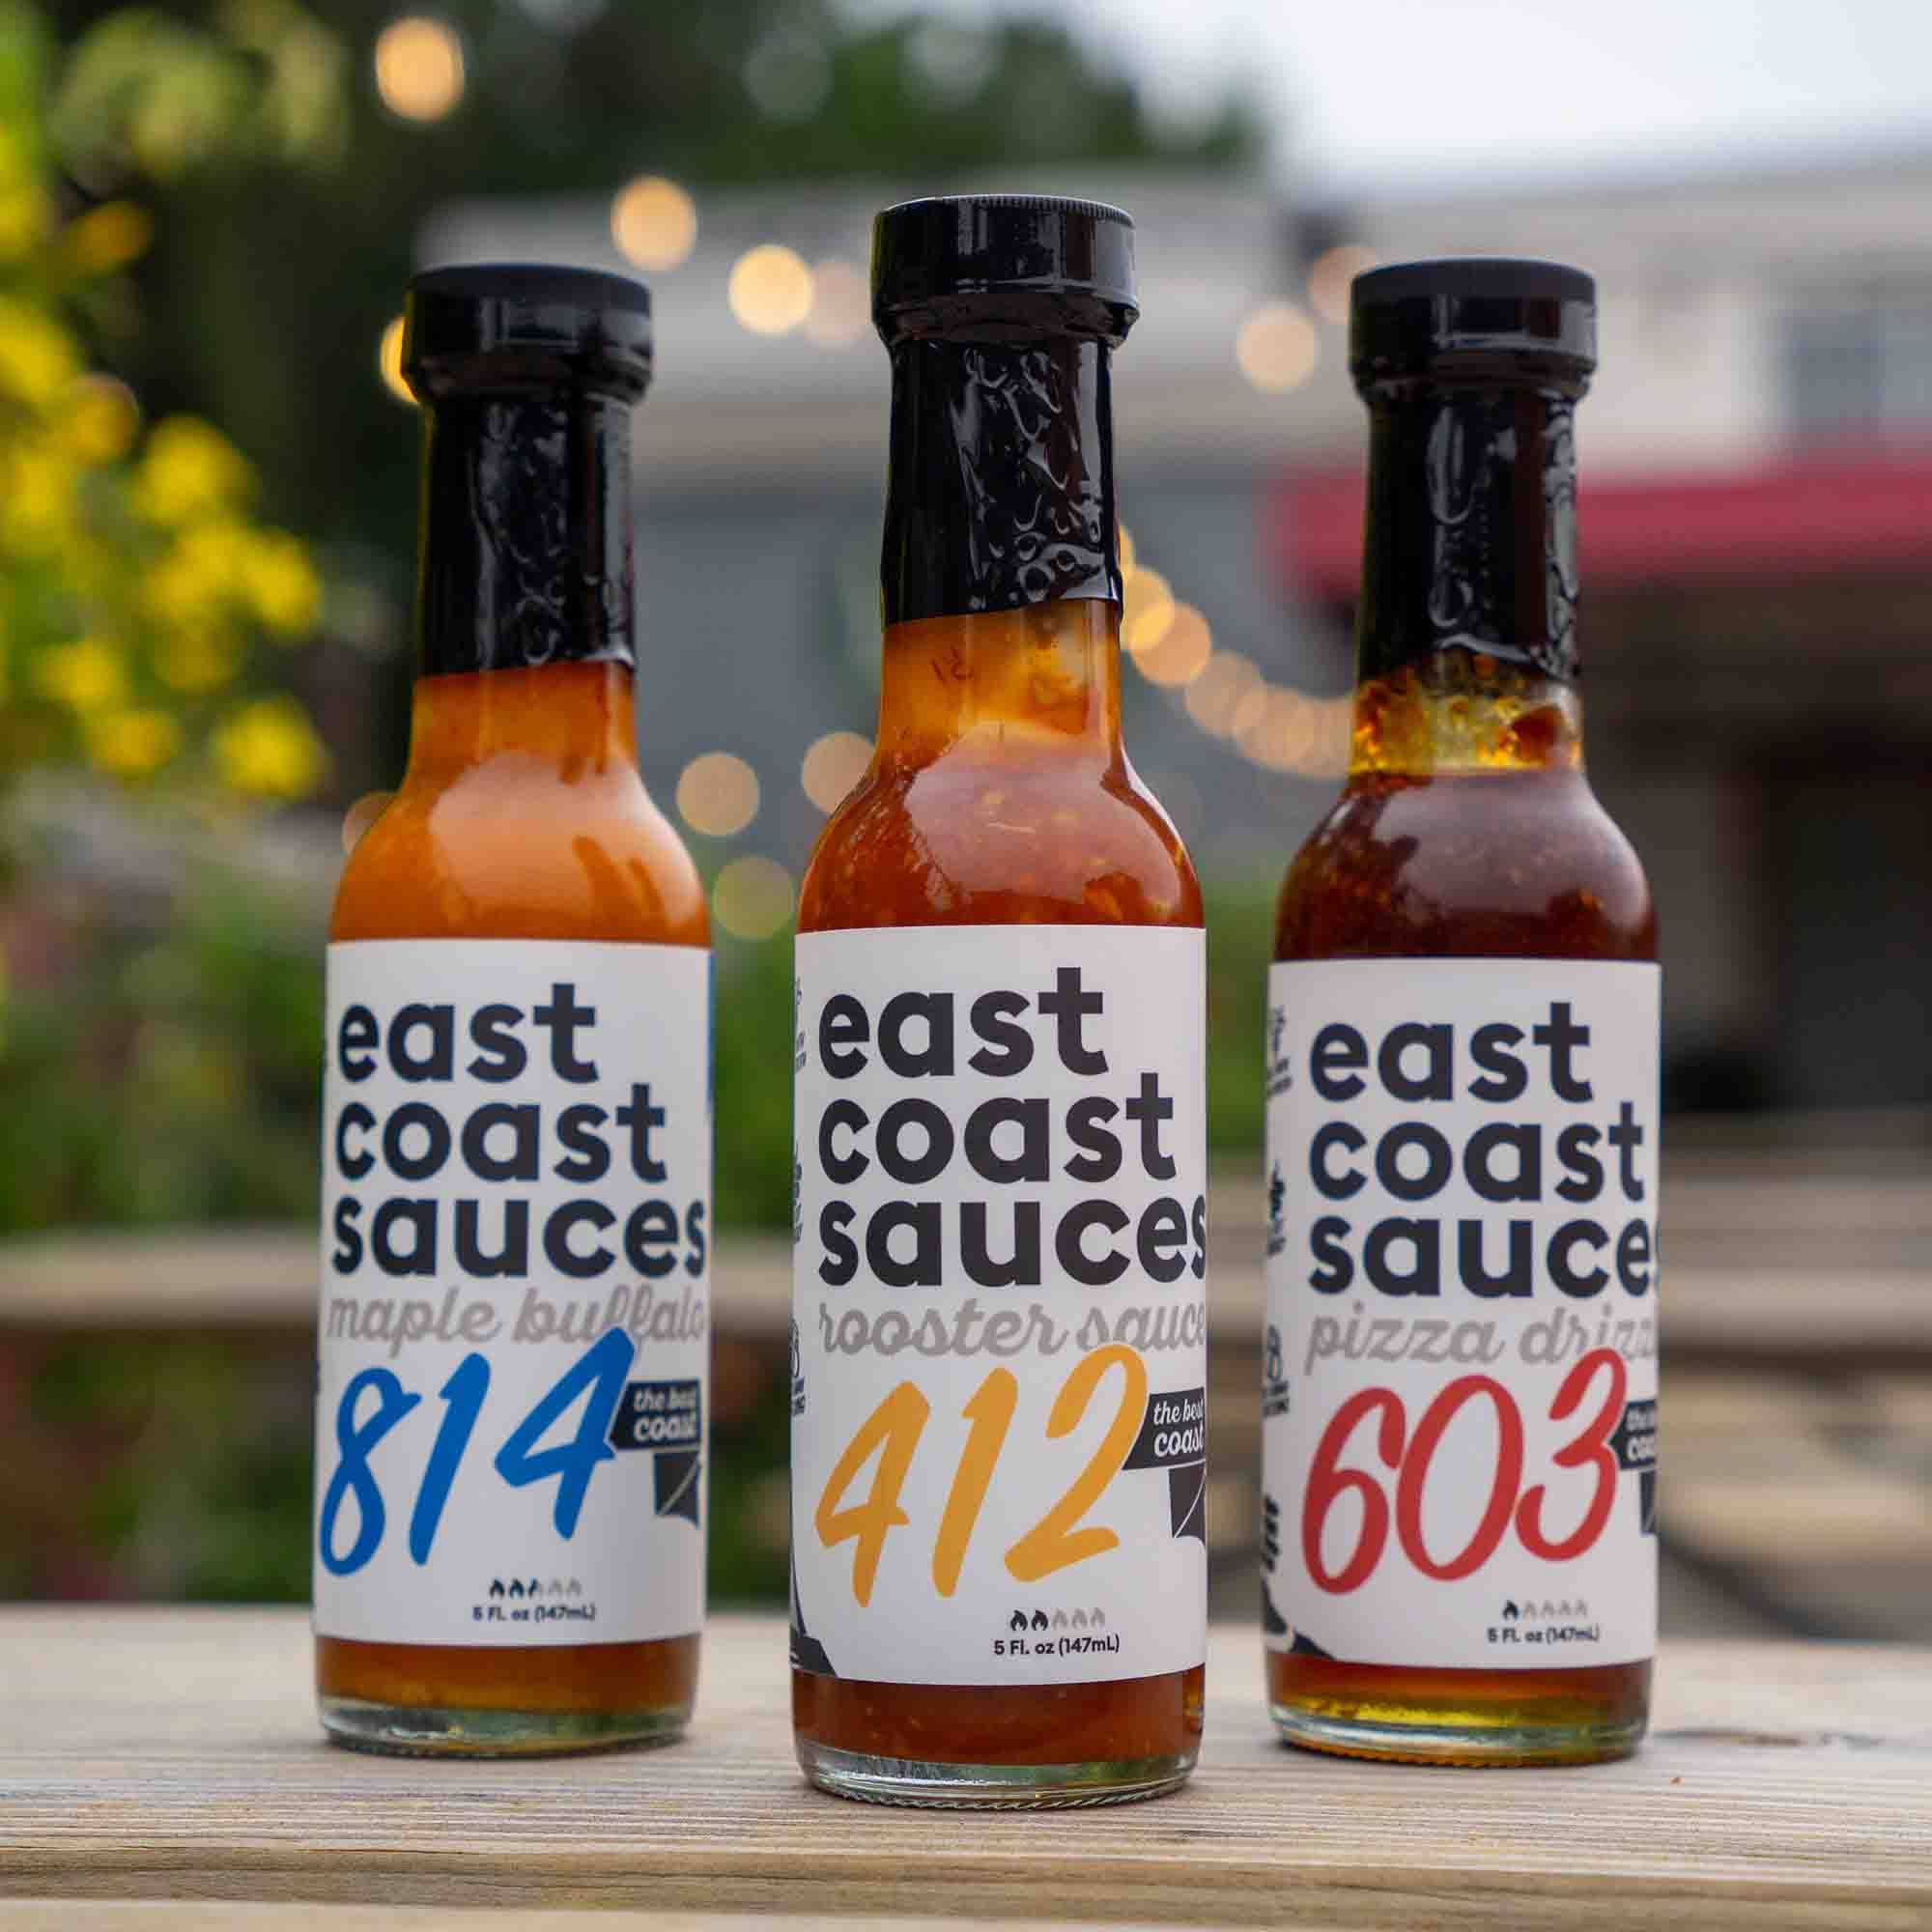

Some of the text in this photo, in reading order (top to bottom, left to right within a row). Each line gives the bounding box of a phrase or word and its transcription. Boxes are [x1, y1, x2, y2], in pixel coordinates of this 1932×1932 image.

[338, 982, 599, 1084] east
[819, 966, 1109, 1079] east
[1310, 1002, 1593, 1103] east
[335, 1083, 668, 1183] coast
[819, 1072, 1177, 1184] coast
[1309, 1101, 1644, 1203] coast
[332, 1195, 707, 1278] sauces
[818, 1195, 1206, 1288] sauces
[1309, 1215, 1659, 1298] sauce
[327, 1287, 502, 1358] maple
[818, 1298, 1205, 1357] rooster sauce
[1304, 1301, 1505, 1376] pizza
[320, 1327, 635, 1577] 814
[1153, 1400, 1181, 1425] the
[1153, 1420, 1205, 1458] coast
[814, 1344, 1148, 1607] 412
[1301, 1347, 1627, 1595] 603
[994, 1639, 1006, 1655] 5
[1035, 1642, 1055, 1655] oz
[1059, 1633, 1120, 1657] (147mL)
